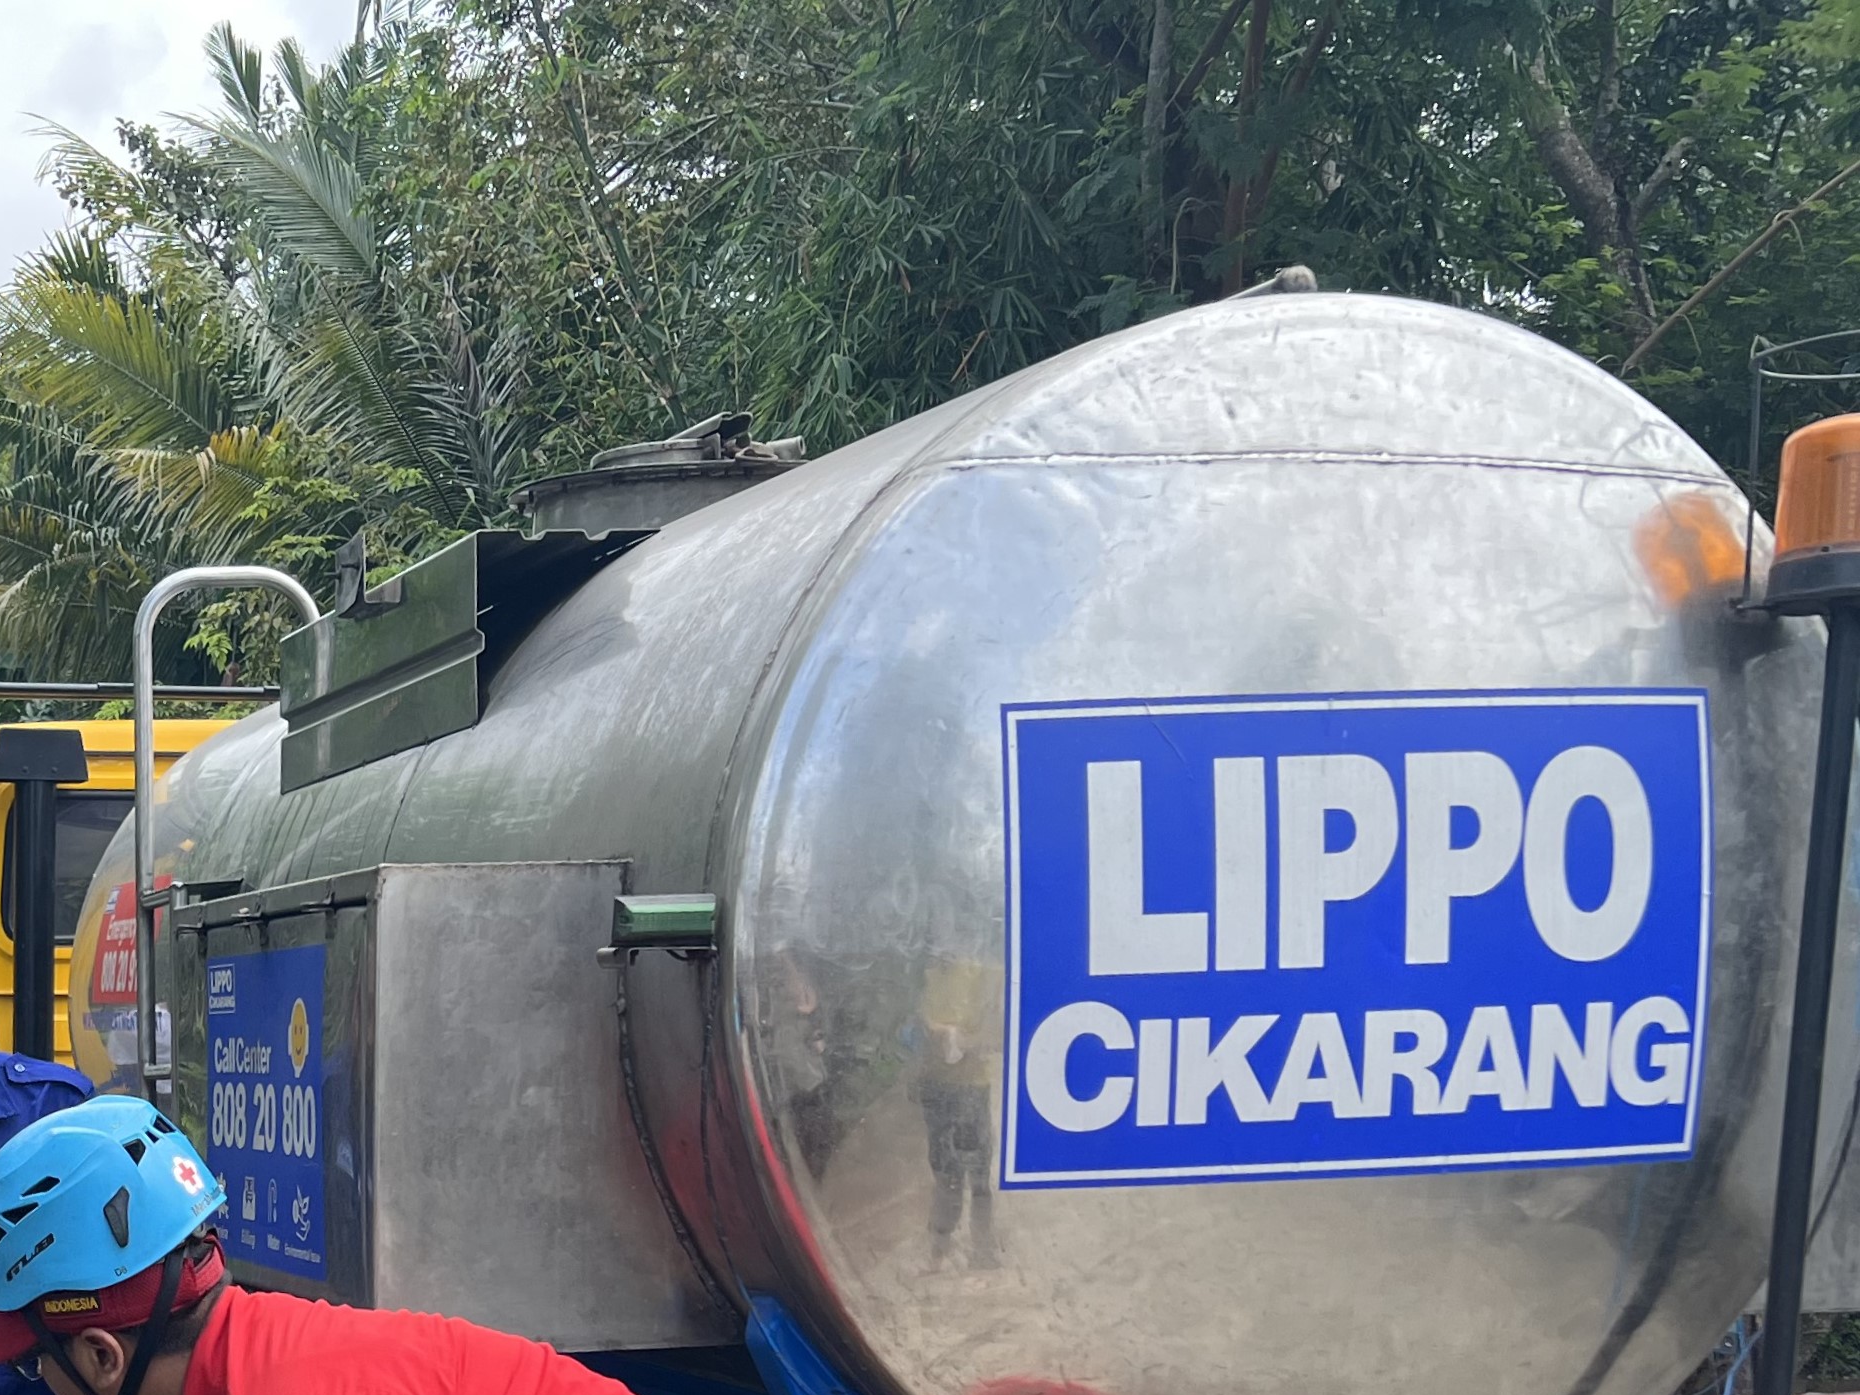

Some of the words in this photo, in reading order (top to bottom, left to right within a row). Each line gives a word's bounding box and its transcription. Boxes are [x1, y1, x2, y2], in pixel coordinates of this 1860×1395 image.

[1086, 744, 1654, 977] LIPPO
[210, 968, 233, 994] LIPPO
[214, 1036, 236, 1074] Call
[236, 1036, 272, 1074] Center
[1025, 996, 1692, 1133] CIKARANG
[212, 1081, 247, 1149] 808
[252, 1082, 277, 1153] 20
[282, 1084, 317, 1159] 800
[44, 1296, 99, 1313] INDONESIA
